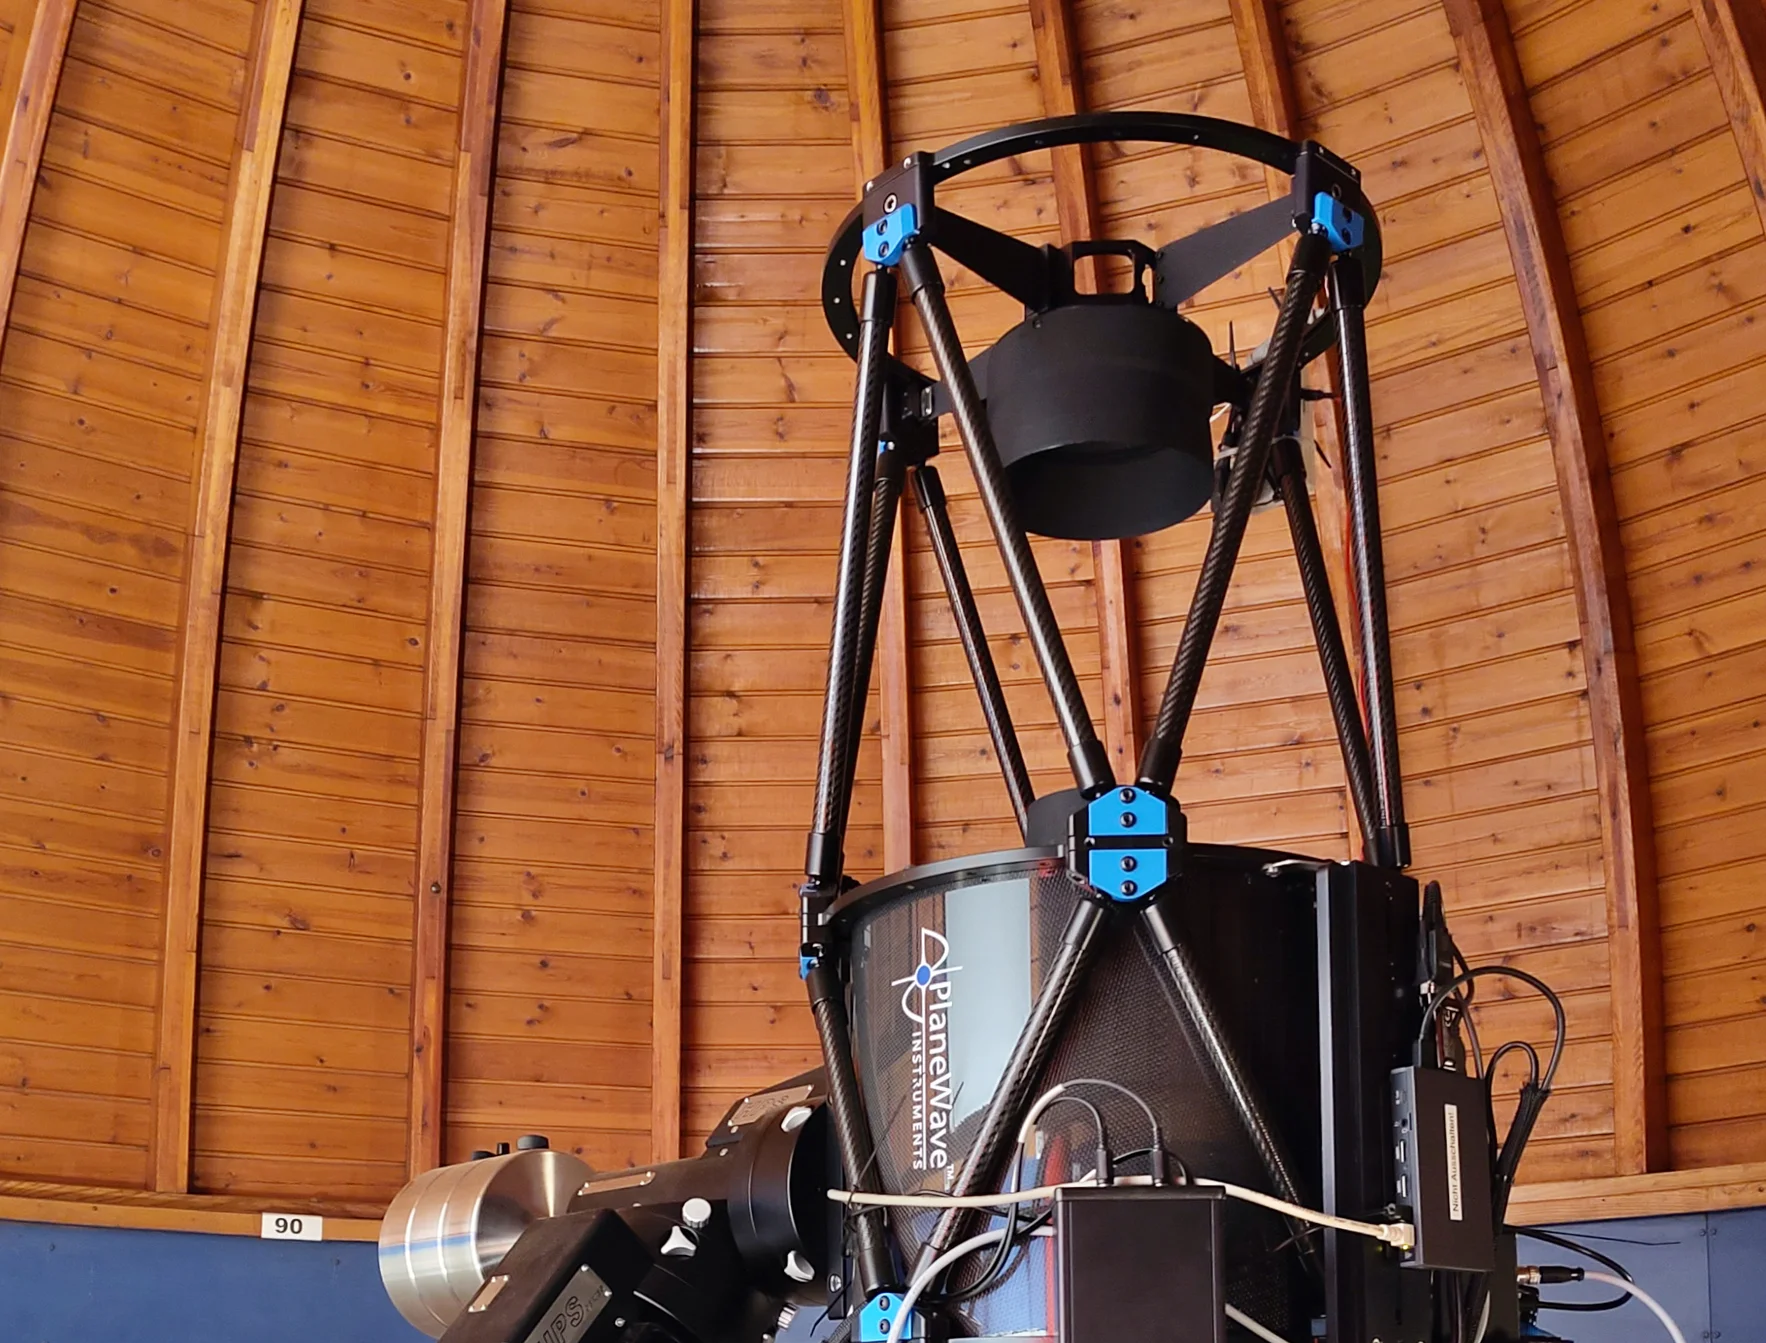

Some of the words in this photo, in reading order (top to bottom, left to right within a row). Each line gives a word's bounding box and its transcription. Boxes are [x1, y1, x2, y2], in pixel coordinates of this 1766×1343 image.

[911, 1031, 923, 1171] INSTRUMENTS
[929, 981, 953, 1169] PlaneWave
[1448, 1111, 1459, 1181] Ausschalten!
[275, 1217, 303, 1234] 90
[1452, 1185, 1460, 1213] Nicht
